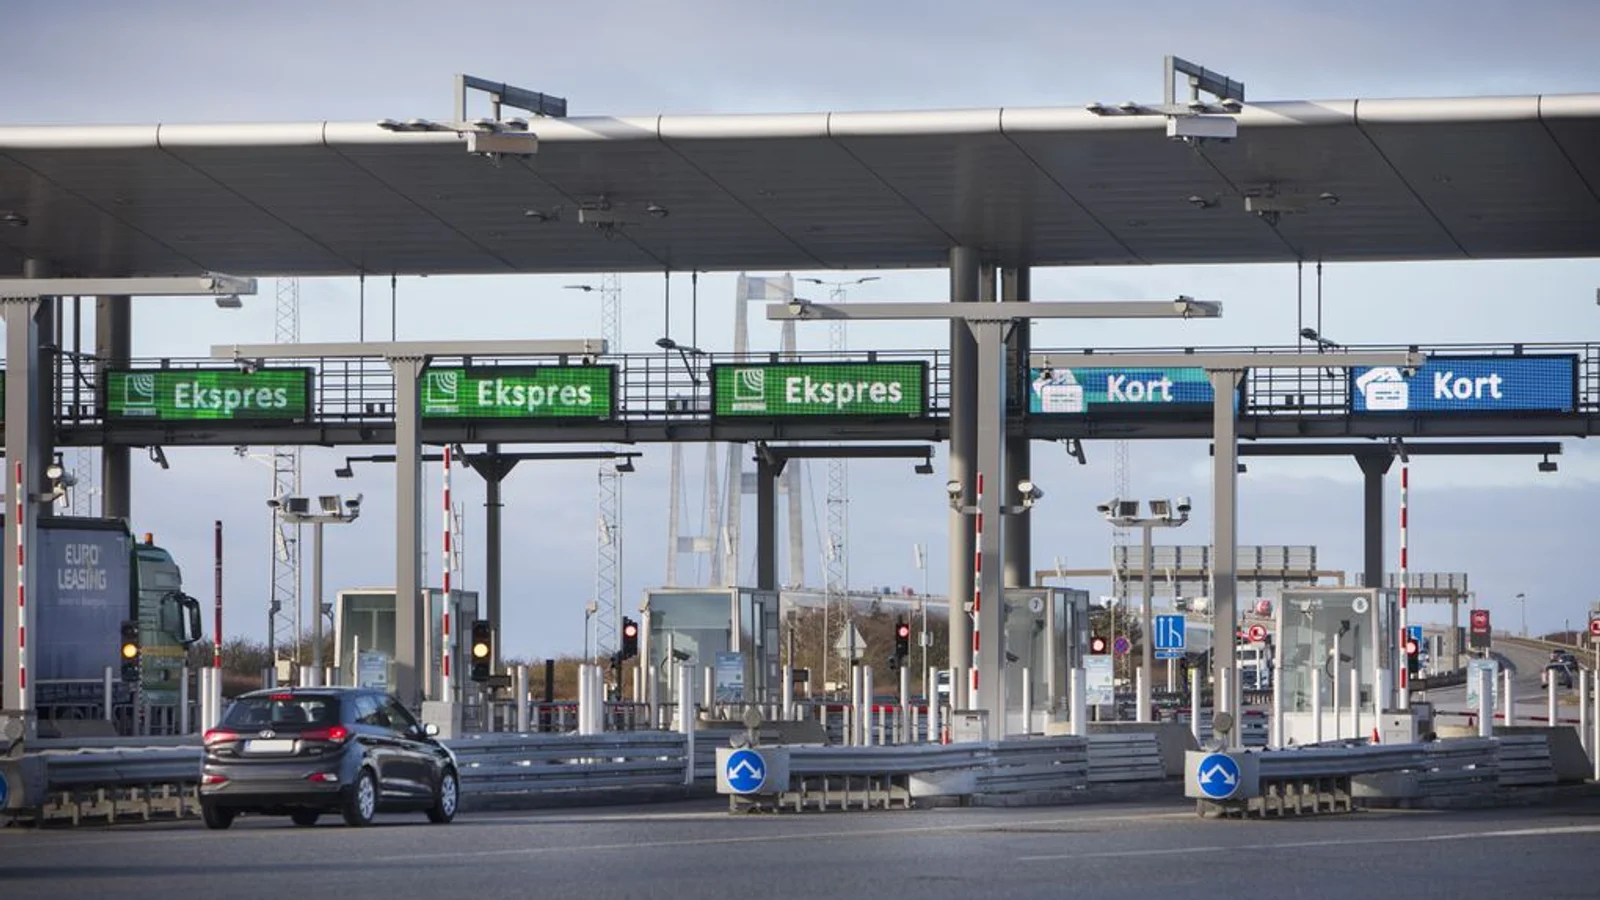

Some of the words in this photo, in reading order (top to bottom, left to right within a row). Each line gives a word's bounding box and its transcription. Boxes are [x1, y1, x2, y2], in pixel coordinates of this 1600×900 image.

[174, 382, 287, 413] Ekspres
[477, 378, 592, 412] Ekspres
[785, 375, 903, 410] Ekspres
[1107, 374, 1174, 402] Kort
[1434, 371, 1503, 400] Kort
[65, 544, 99, 565] EURO
[58, 568, 107, 590] LEASING
